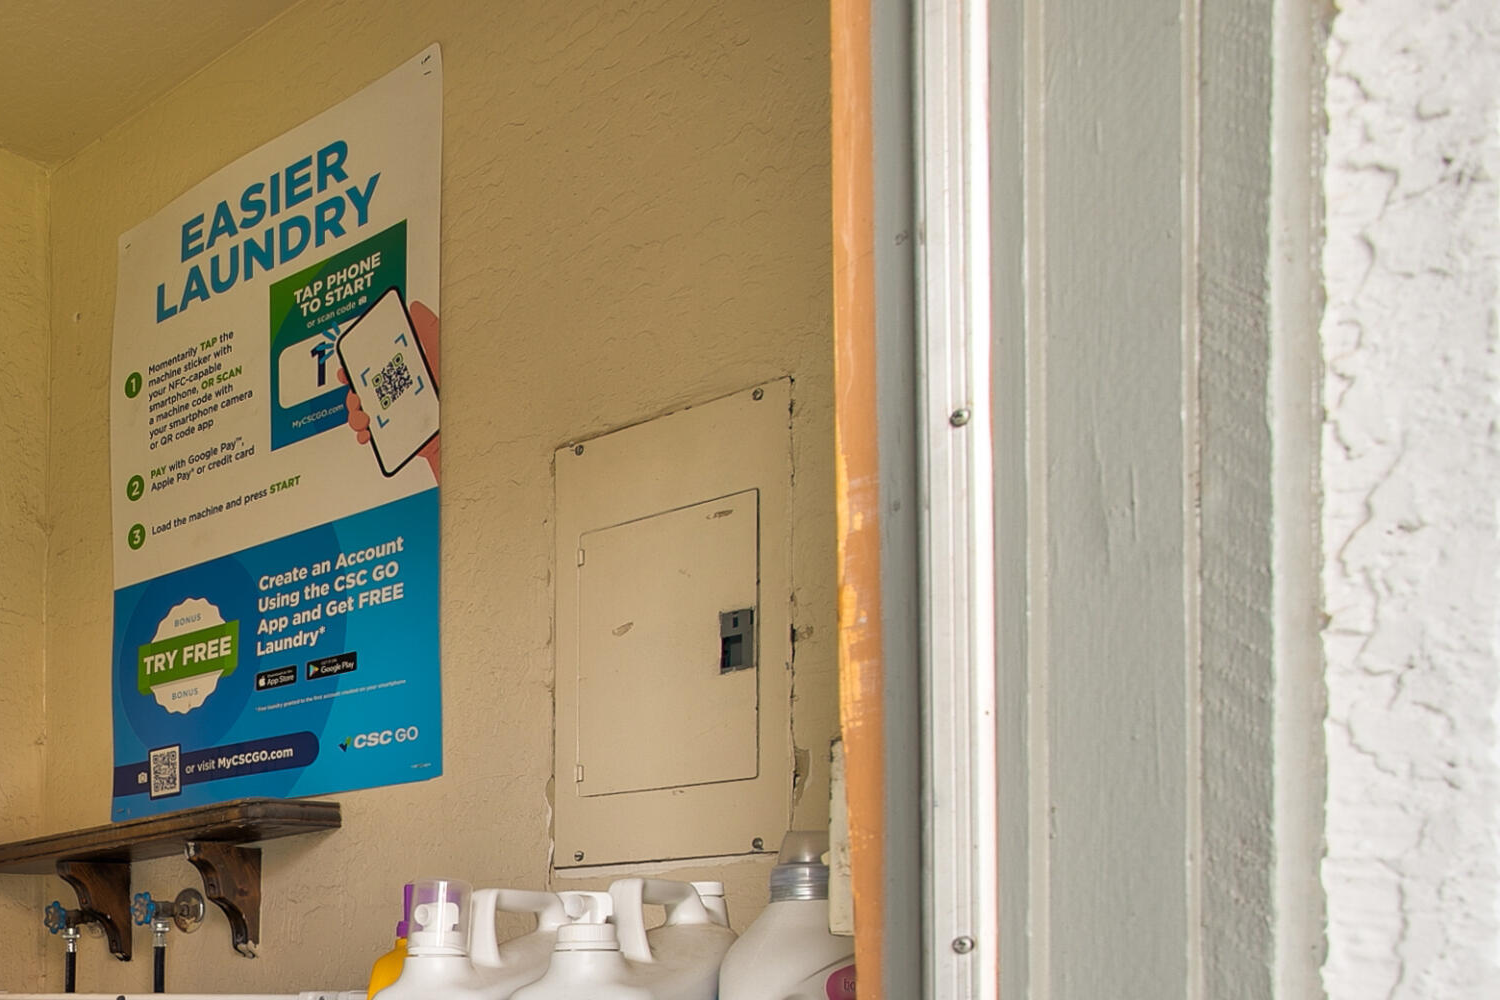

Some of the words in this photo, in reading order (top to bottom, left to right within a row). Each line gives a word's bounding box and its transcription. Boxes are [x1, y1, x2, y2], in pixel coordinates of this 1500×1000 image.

[180, 140, 349, 263] EASIER
[156, 172, 381, 323] LAUNDRY
[293, 281, 323, 304] TAP
[327, 251, 381, 289] PHONE
[300, 298, 321, 317] TO
[325, 272, 375, 307] START
[306, 320, 316, 328] or
[317, 311, 336, 324] scan
[336, 301, 356, 315] code
[148, 346, 198, 375] Momentarily
[200, 337, 218, 351] TAP
[219, 331, 234, 343] the
[148, 368, 182, 388] machine
[183, 354, 212, 373] sticker
[213, 344, 233, 359] with
[148, 386, 167, 402] your
[168, 362, 222, 390] NFC-capable
[148, 386, 199, 412] smartphone,
[201, 378, 214, 390] OR
[216, 365, 243, 384] SCAN
[149, 416, 155, 425] a
[156, 402, 190, 422] machine
[191, 392, 213, 408] code
[214, 383, 234, 398] with
[149, 424, 168, 440] your
[169, 403, 219, 431] smartphone
[220, 390, 253, 408] camera
[292, 403, 344, 429] MyCSCGO.com
[149, 441, 159, 450] or
[160, 433, 174, 447] QR
[175, 425, 196, 441] code
[197, 418, 214, 434] app
[150, 465, 167, 479] PAY
[169, 458, 186, 473] with
[188, 447, 218, 466] Google
[151, 476, 175, 493] Apple
[196, 464, 206, 475] or
[208, 453, 233, 471] credit
[235, 445, 255, 461] card
[131, 480, 140, 497] 2
[152, 519, 172, 536] Load
[174, 515, 187, 528] the
[189, 503, 224, 523] machine
[226, 497, 242, 511] and
[244, 488, 268, 505] press
[269, 475, 301, 494] START
[132, 528, 141, 545] 3
[258, 565, 308, 591] Create
[311, 560, 331, 577] an
[335, 536, 404, 571] Account
[258, 589, 300, 614] Using
[304, 583, 330, 601] the
[334, 569, 368, 593] CSC
[372, 561, 399, 582] GO
[174, 613, 202, 628] BONUS
[257, 617, 288, 636] App
[292, 603, 322, 627] and
[325, 597, 354, 618] Get
[358, 582, 404, 609] FREE
[143, 649, 179, 675] TRY
[182, 635, 232, 666] FREE
[320, 664, 341, 674] Google
[341, 661, 354, 670] Play
[171, 687, 199, 701] BONUS
[267, 677, 279, 687] App
[279, 674, 295, 684] Store
[353, 729, 393, 749] CSC
[395, 725, 419, 743] GO
[185, 762, 196, 774] or
[197, 757, 216, 772] visit
[217, 746, 294, 770] MyCSCGO.com
